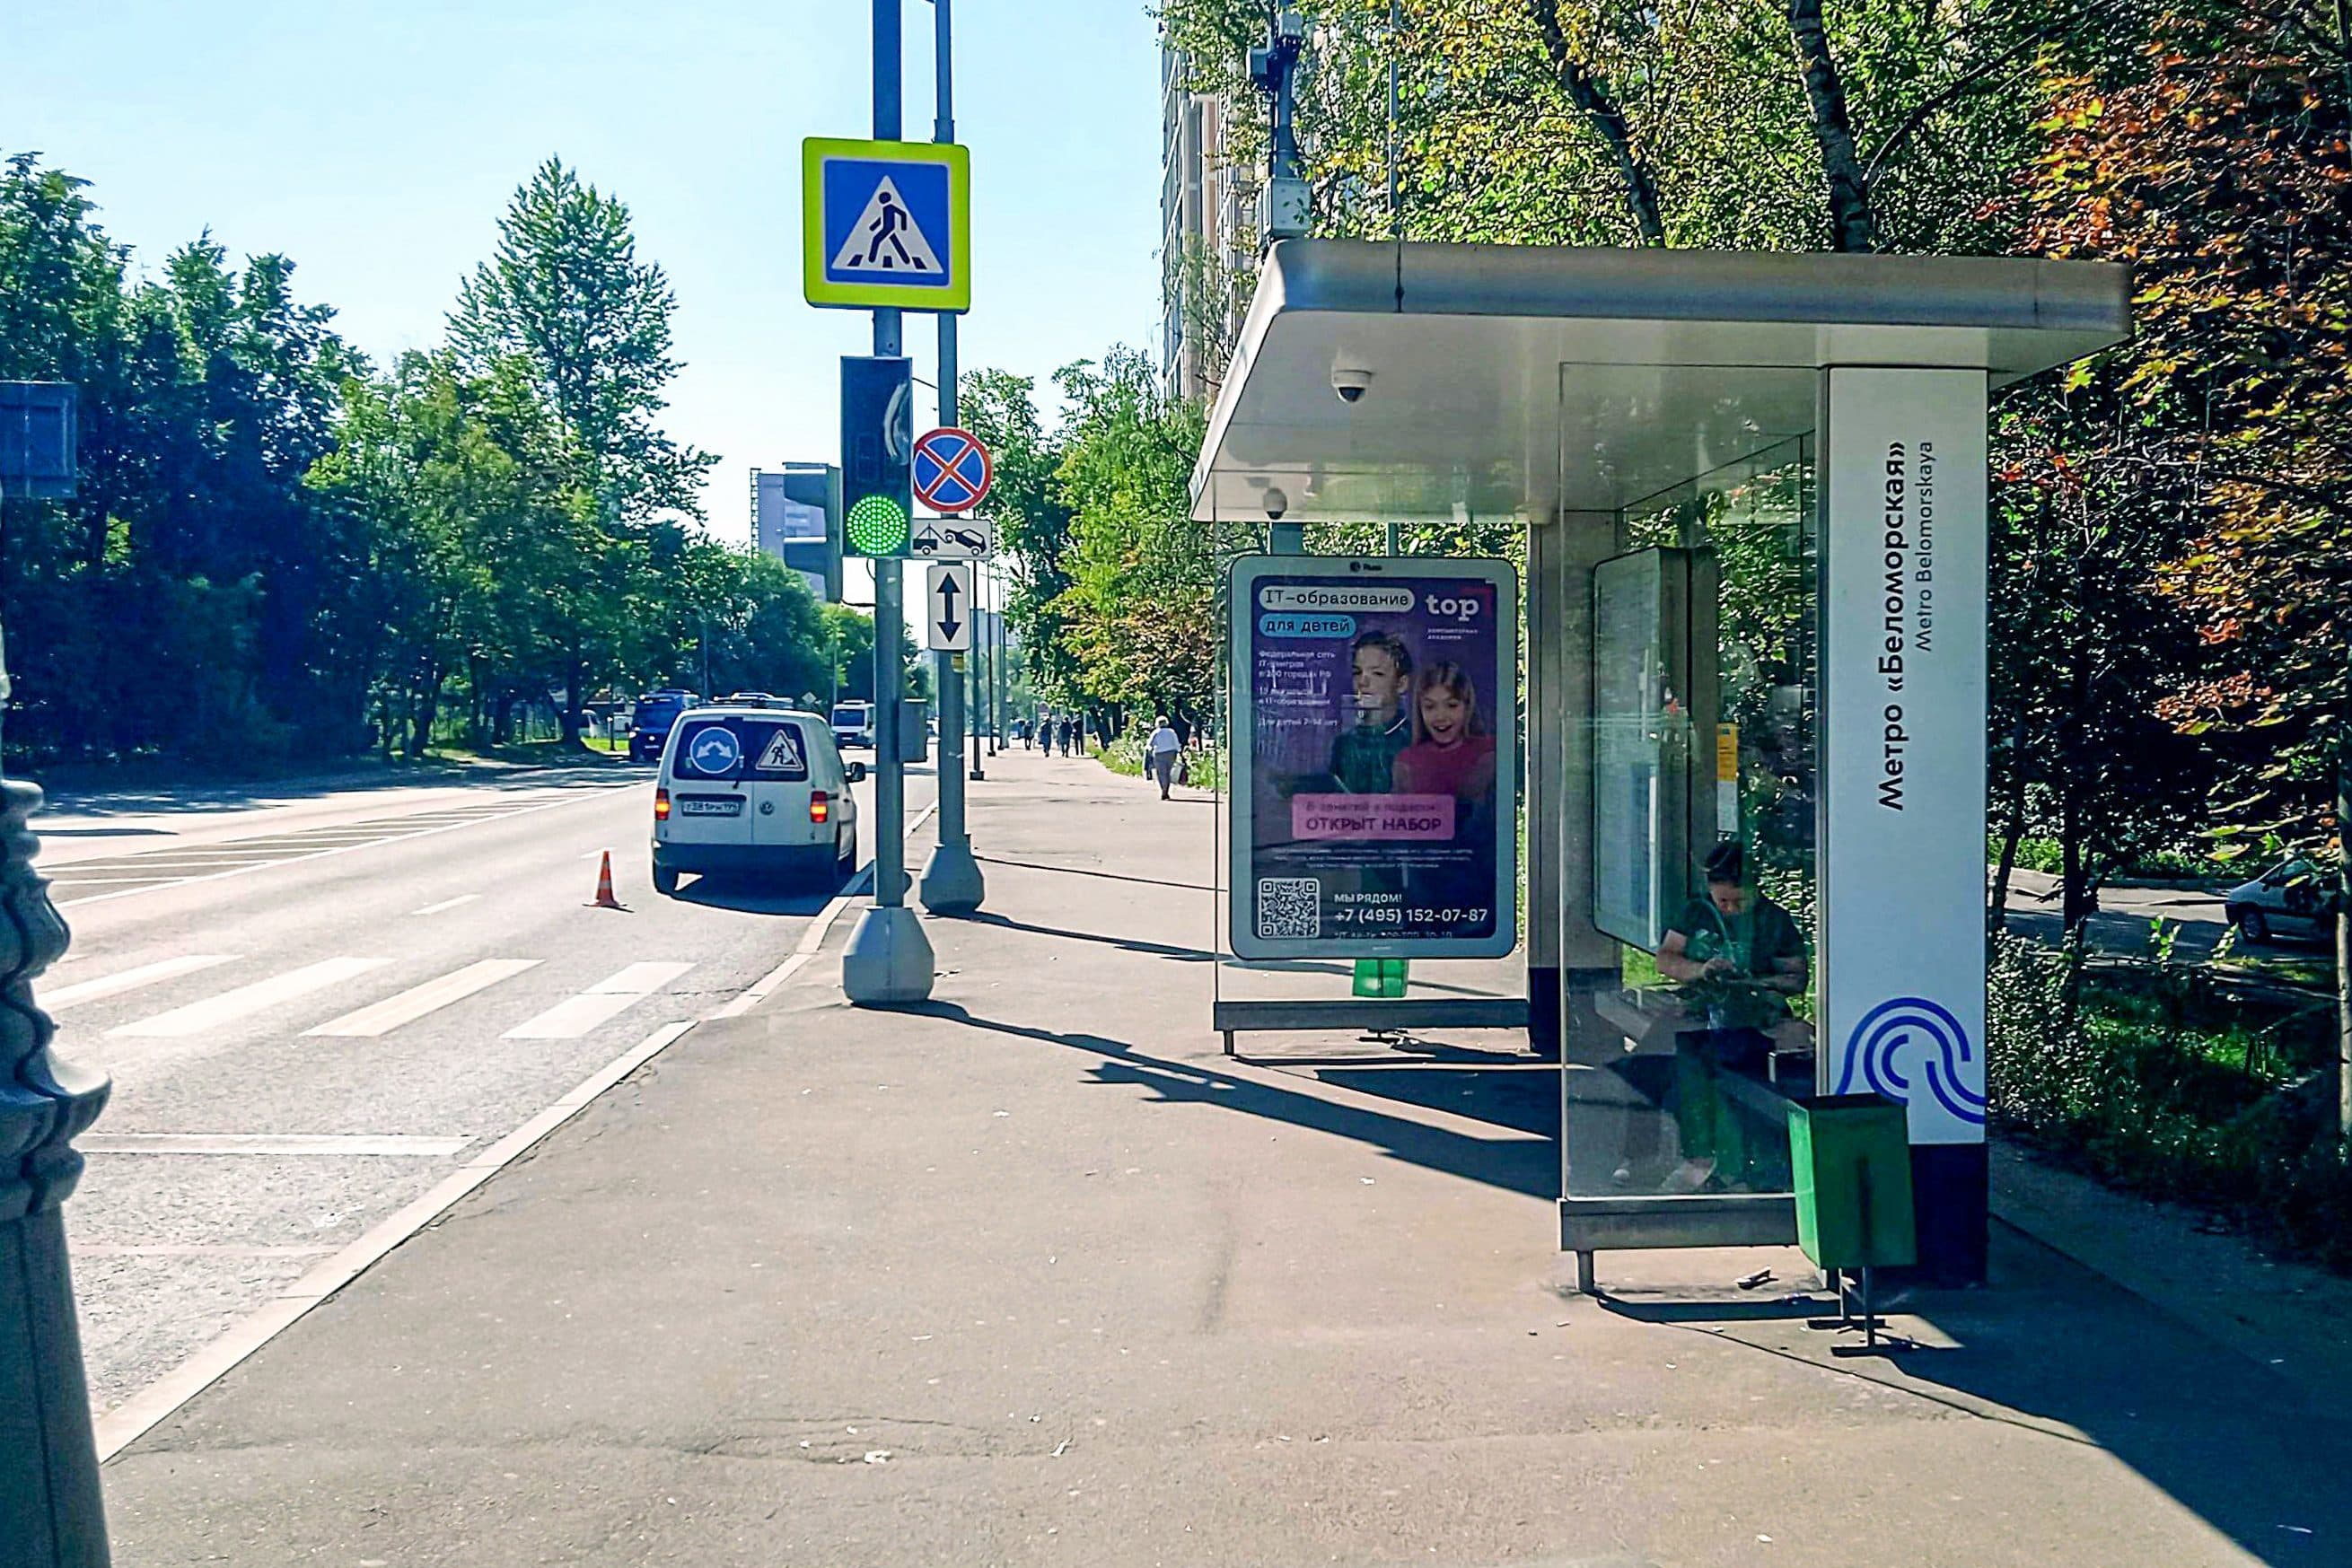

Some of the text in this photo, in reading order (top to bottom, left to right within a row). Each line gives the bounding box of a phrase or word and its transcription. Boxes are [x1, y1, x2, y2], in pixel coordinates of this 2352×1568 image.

[1915, 442, 1934, 653] Metro Belomorskaya
[1265, 589, 1409, 607] IT-образование
[1426, 594, 1479, 621] top
[1265, 617, 1350, 633] для детей
[1878, 442, 1909, 811] Метро «Беломорская»
[1306, 817, 1442, 832] ОТКРЫТ НАБОР
[1334, 893, 1402, 904] МЫ РЯДОМ!
[1335, 907, 1488, 924] +7 (495) 152-07-87
